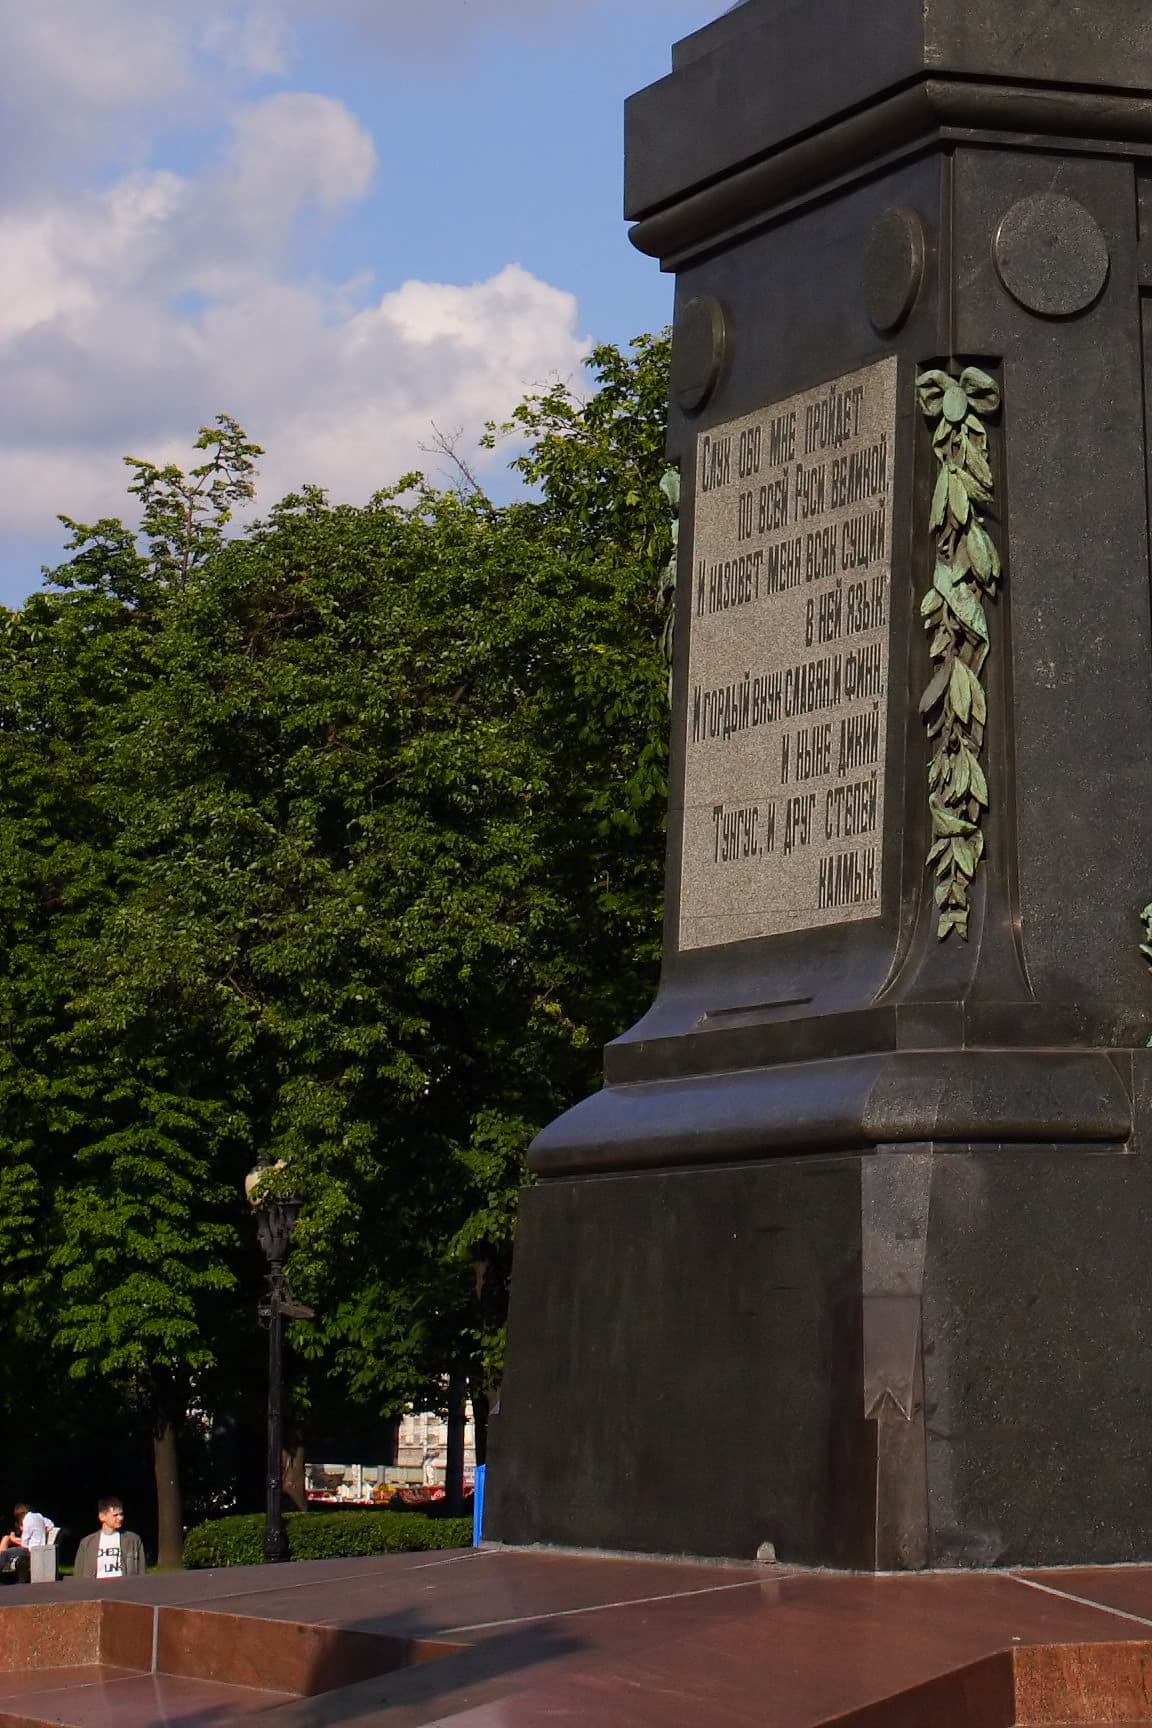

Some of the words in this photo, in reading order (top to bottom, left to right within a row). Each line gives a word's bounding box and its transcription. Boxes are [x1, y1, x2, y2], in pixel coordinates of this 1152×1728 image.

[702, 435, 732, 492] СЛУХ
[739, 425, 762, 479] ОБО
[769, 412, 797, 468] МНЕ
[804, 383, 864, 455] ПРОЙДЕТ
[738, 491, 753, 542] ПО
[759, 466, 789, 535] ВСЕЙ
[795, 463, 826, 522] РУСИ
[697, 559, 706, 617] И
[709, 549, 764, 614] НАЗОВЕТ
[767, 537, 802, 596] МЕНЯ
[806, 523, 837, 583] ВСЯК
[841, 496, 887, 571] СУЩИЙ
[805, 598, 814, 647] В
[819, 577, 842, 643] НЕЙ
[693, 684, 702, 743] И
[702, 670, 751, 741] ГОРДЫЙ
[752, 671, 783, 727] ВНУК
[833, 654, 842, 705] И
[781, 733, 790, 784] И
[797, 723, 832, 781] НЫНЕ
[838, 700, 880, 778] ДИКИЙ
[767, 802, 777, 852] И
[784, 793, 817, 856] ДРУГ
[824, 769, 879, 841] СТЕПЕЙ
